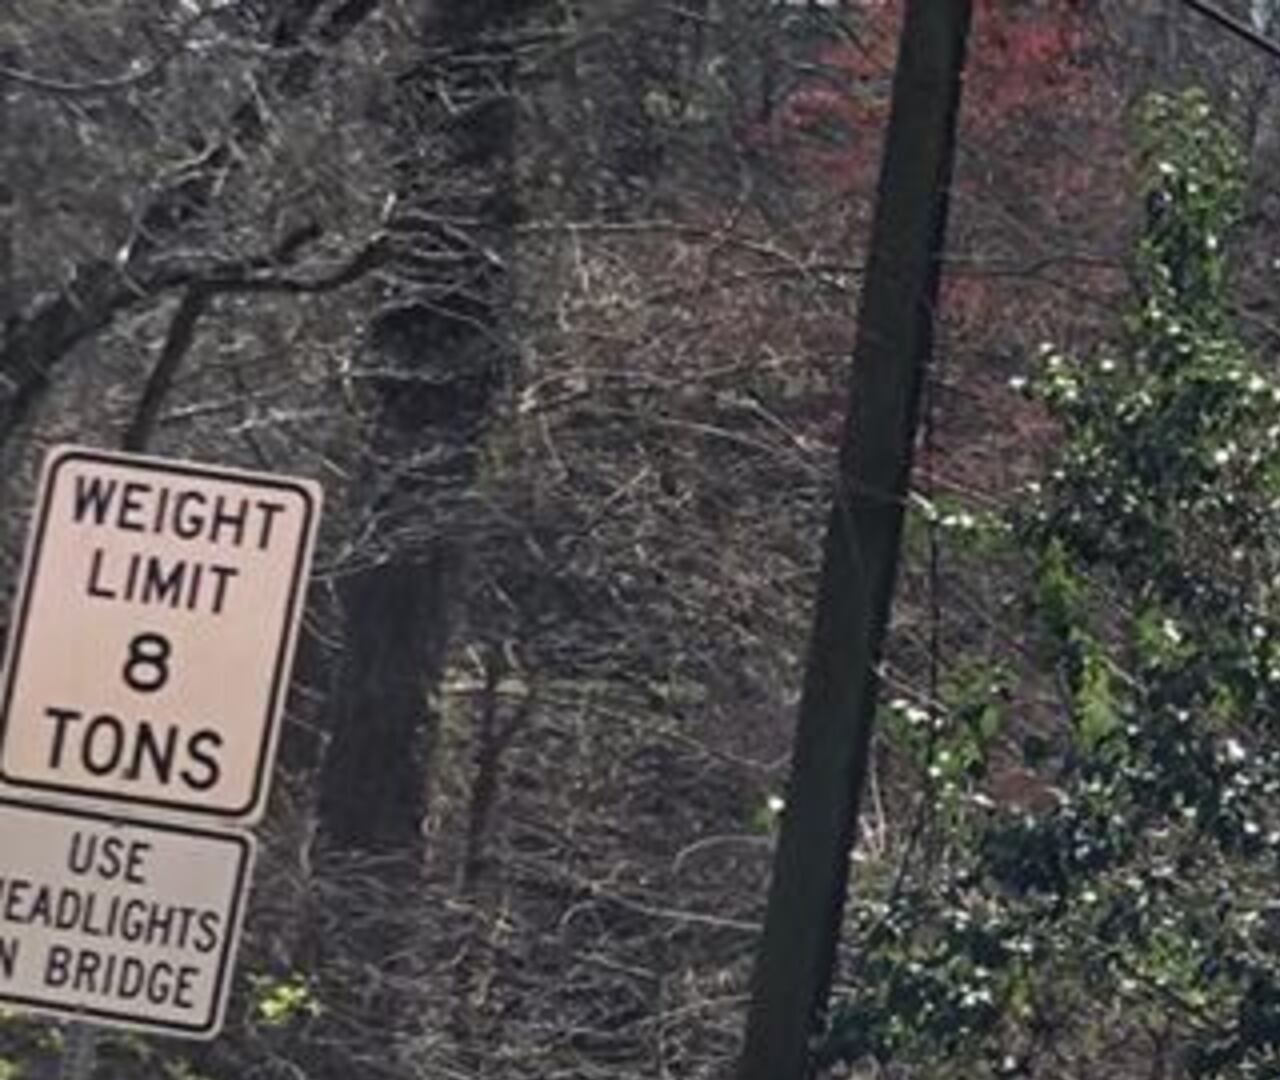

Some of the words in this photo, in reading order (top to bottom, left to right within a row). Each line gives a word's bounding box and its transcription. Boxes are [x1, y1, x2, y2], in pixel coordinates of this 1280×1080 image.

[72, 476, 286, 549] WEIGHT
[86, 549, 239, 614] LIMIT
[123, 632, 172, 693] 8
[45, 707, 224, 791] TONS
[67, 831, 151, 885] USE
[0, 878, 221, 954] EADLIGHTS
[0, 936, 19, 980] N
[43, 944, 200, 1009] BRIDGE
